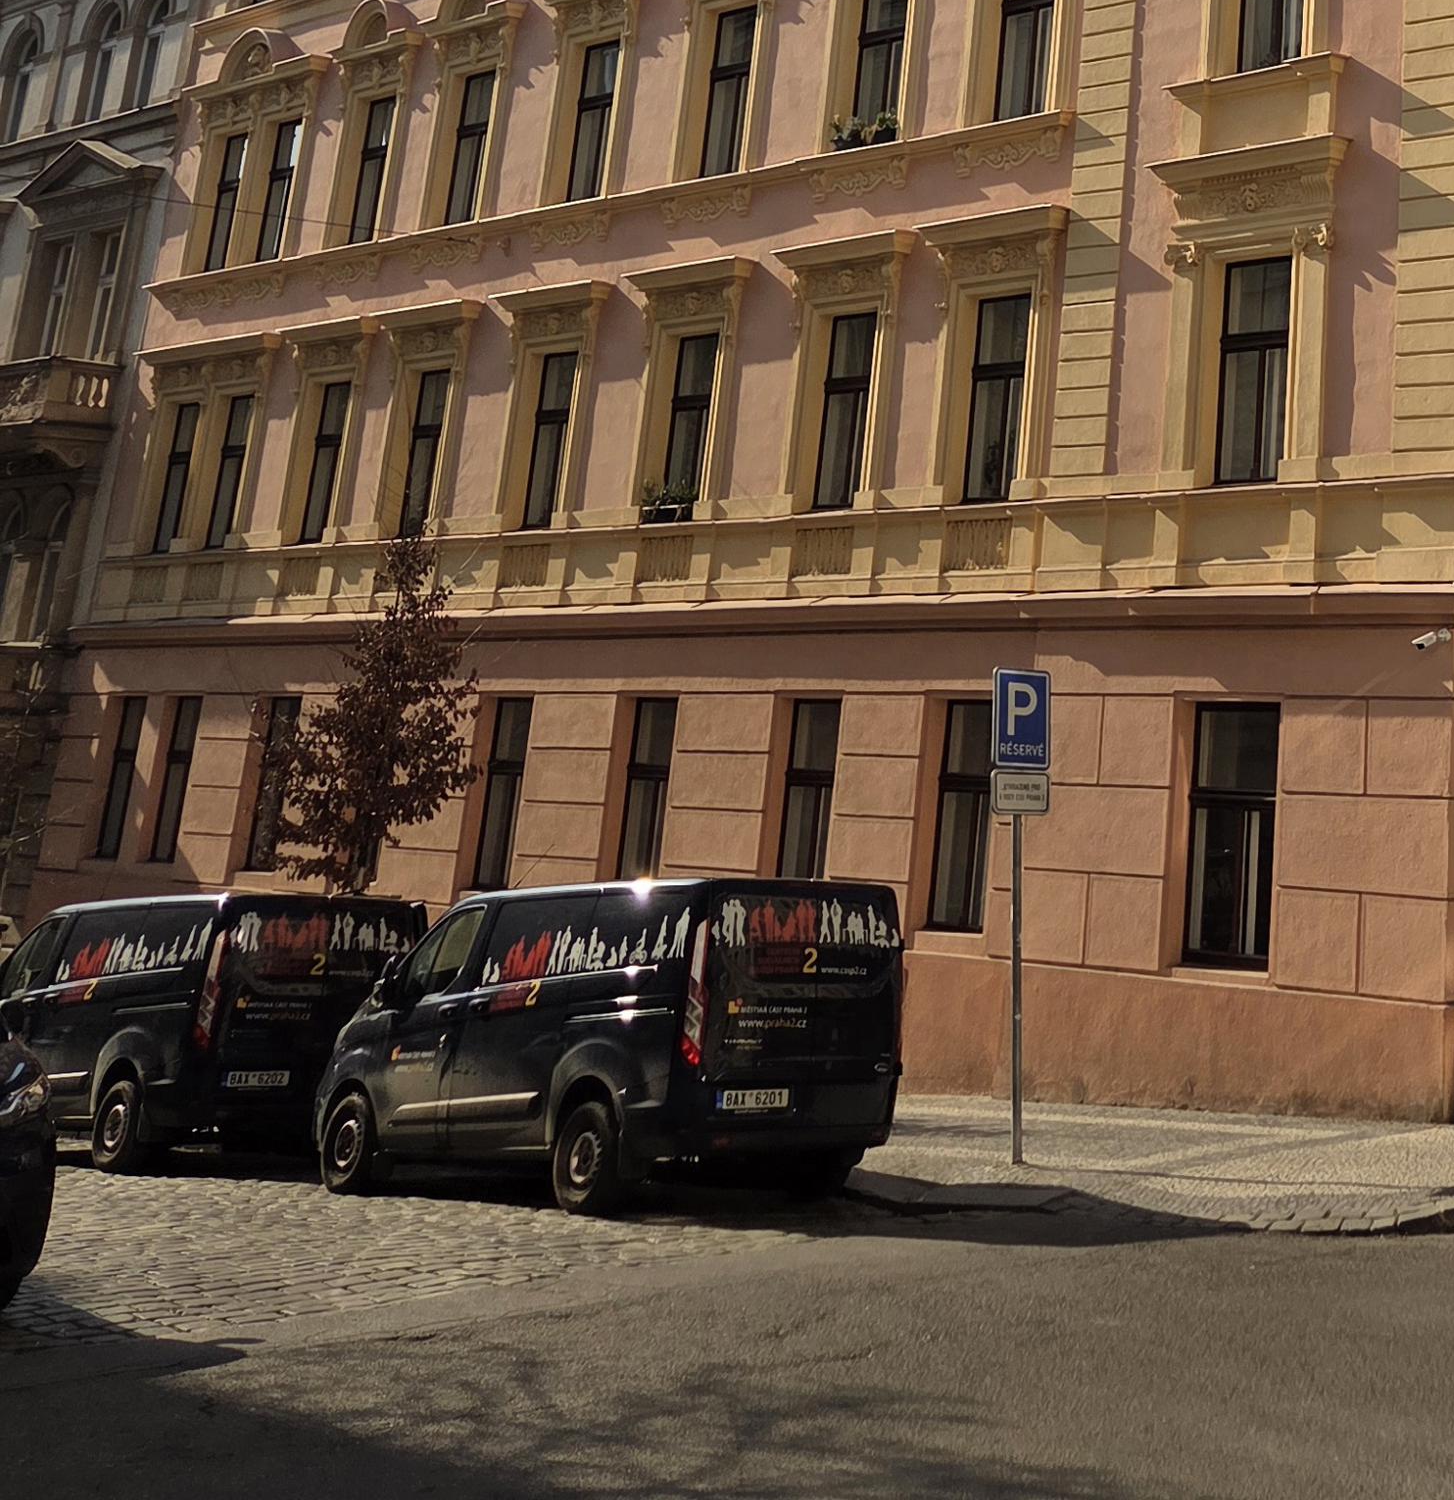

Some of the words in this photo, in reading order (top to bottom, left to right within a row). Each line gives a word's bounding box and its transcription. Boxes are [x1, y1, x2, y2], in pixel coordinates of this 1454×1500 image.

[1007, 682, 1038, 736] P
[1000, 741, 1044, 757] RÉSERVÉ
[310, 954, 327, 976] 2
[803, 948, 818, 973] 2
[83, 979, 99, 1000] 2
[525, 980, 542, 1006] 2
[738, 1018, 807, 1030] www.praha2.cz
[257, 1072, 284, 1085] 6202
[726, 1092, 746, 1107] 8AX
[755, 1090, 783, 1106] 6201
